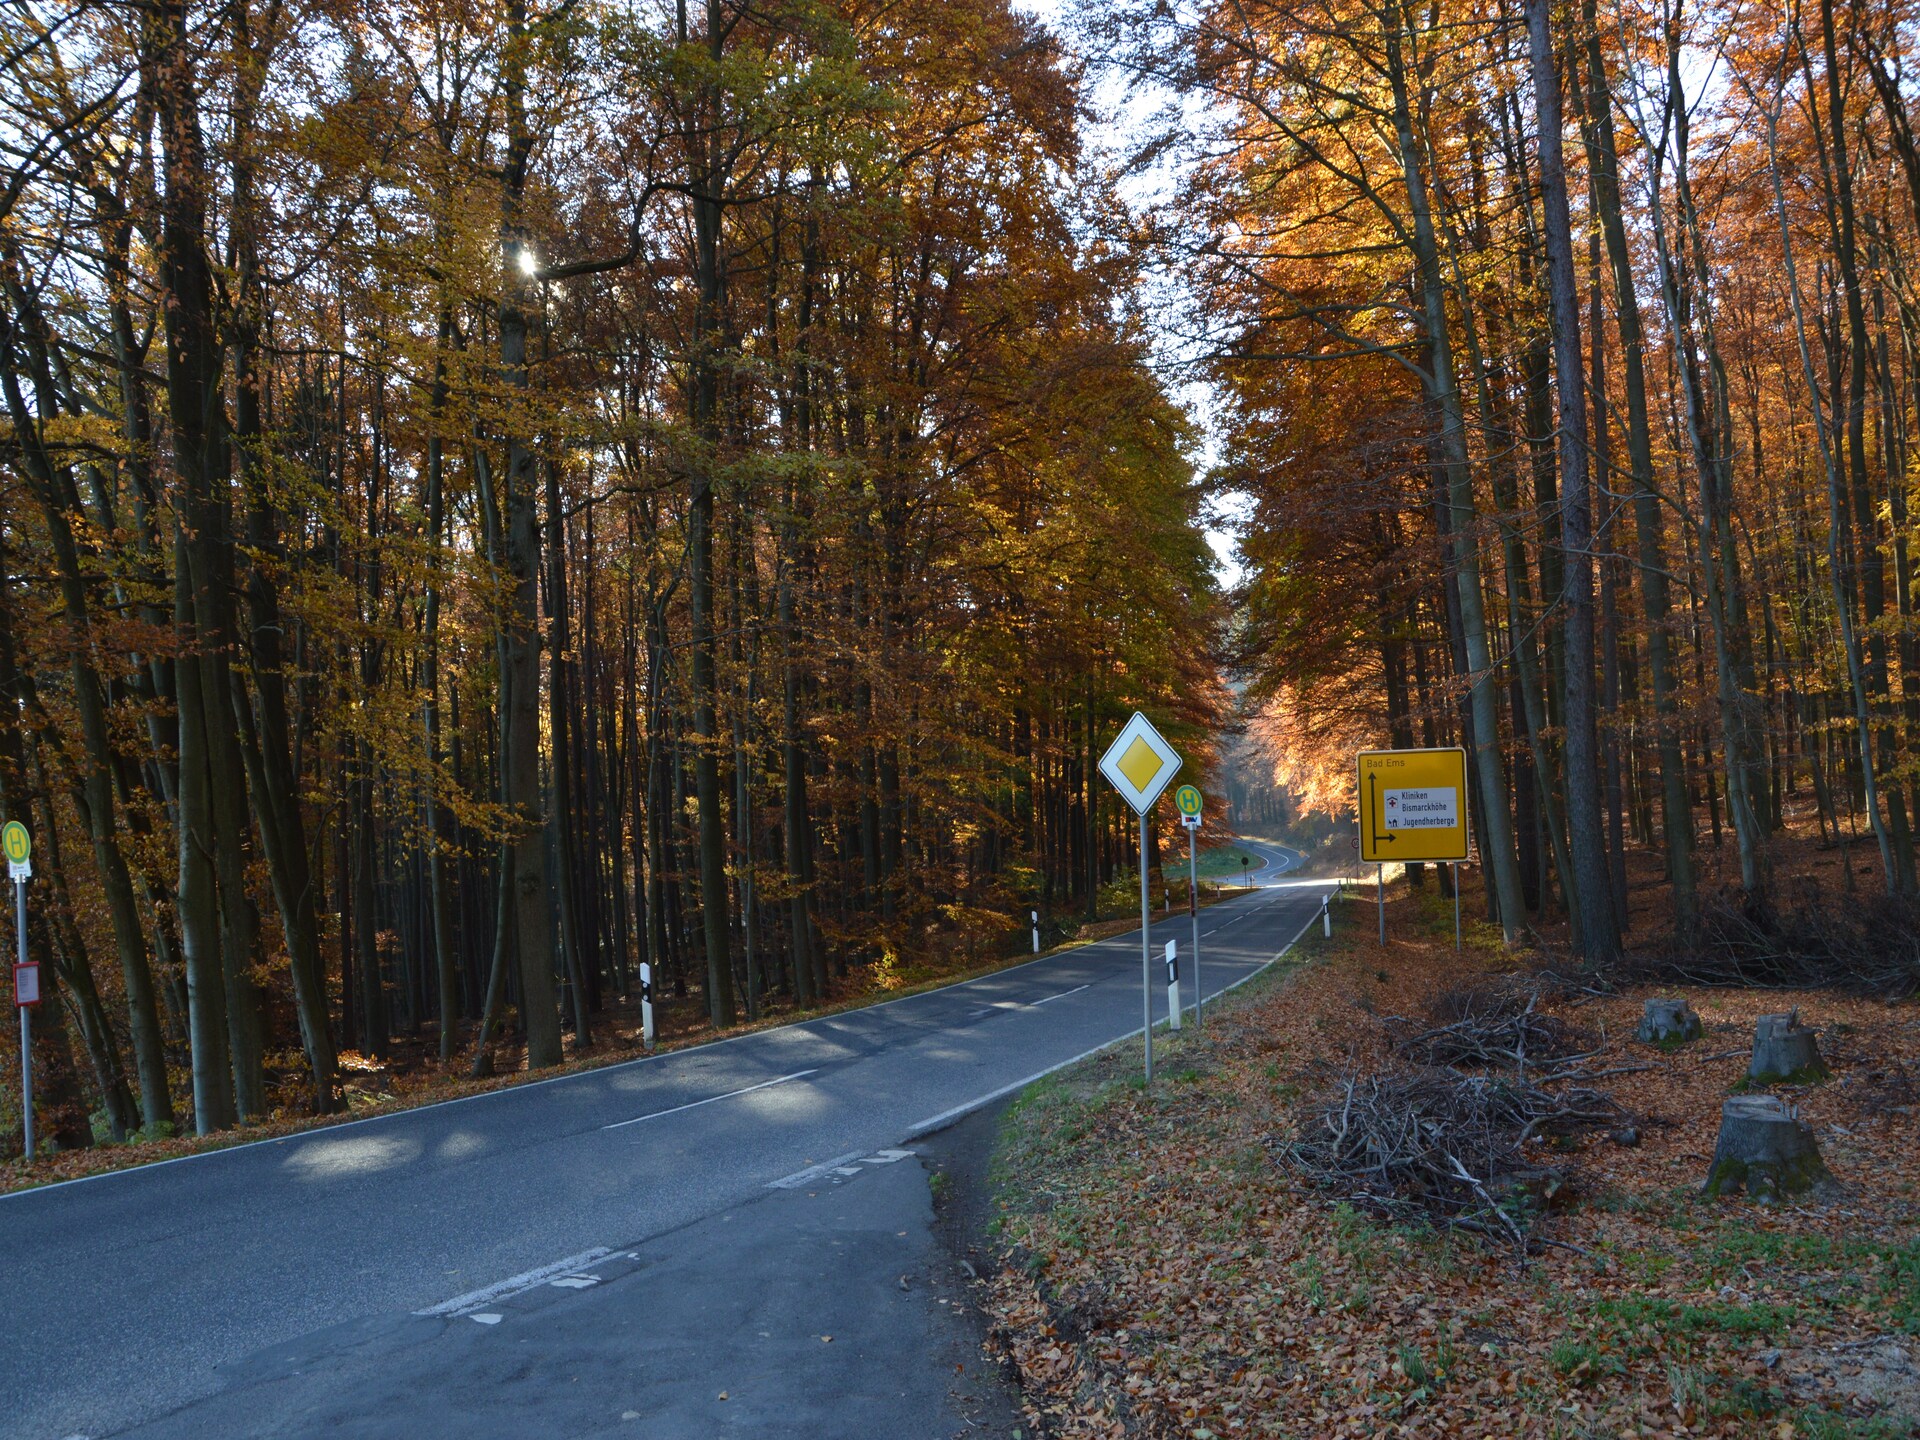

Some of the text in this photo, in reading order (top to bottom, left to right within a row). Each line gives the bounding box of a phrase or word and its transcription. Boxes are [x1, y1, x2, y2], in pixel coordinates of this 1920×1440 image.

[1367, 759, 1405, 768] Bad Ems
[1402, 792, 1428, 800] Kliniken
[1182, 793, 1196, 809] H
[1402, 803, 1447, 812] Bismarckhöhe
[1403, 817, 1455, 827] Jugendherberge
[10, 831, 23, 854] H
